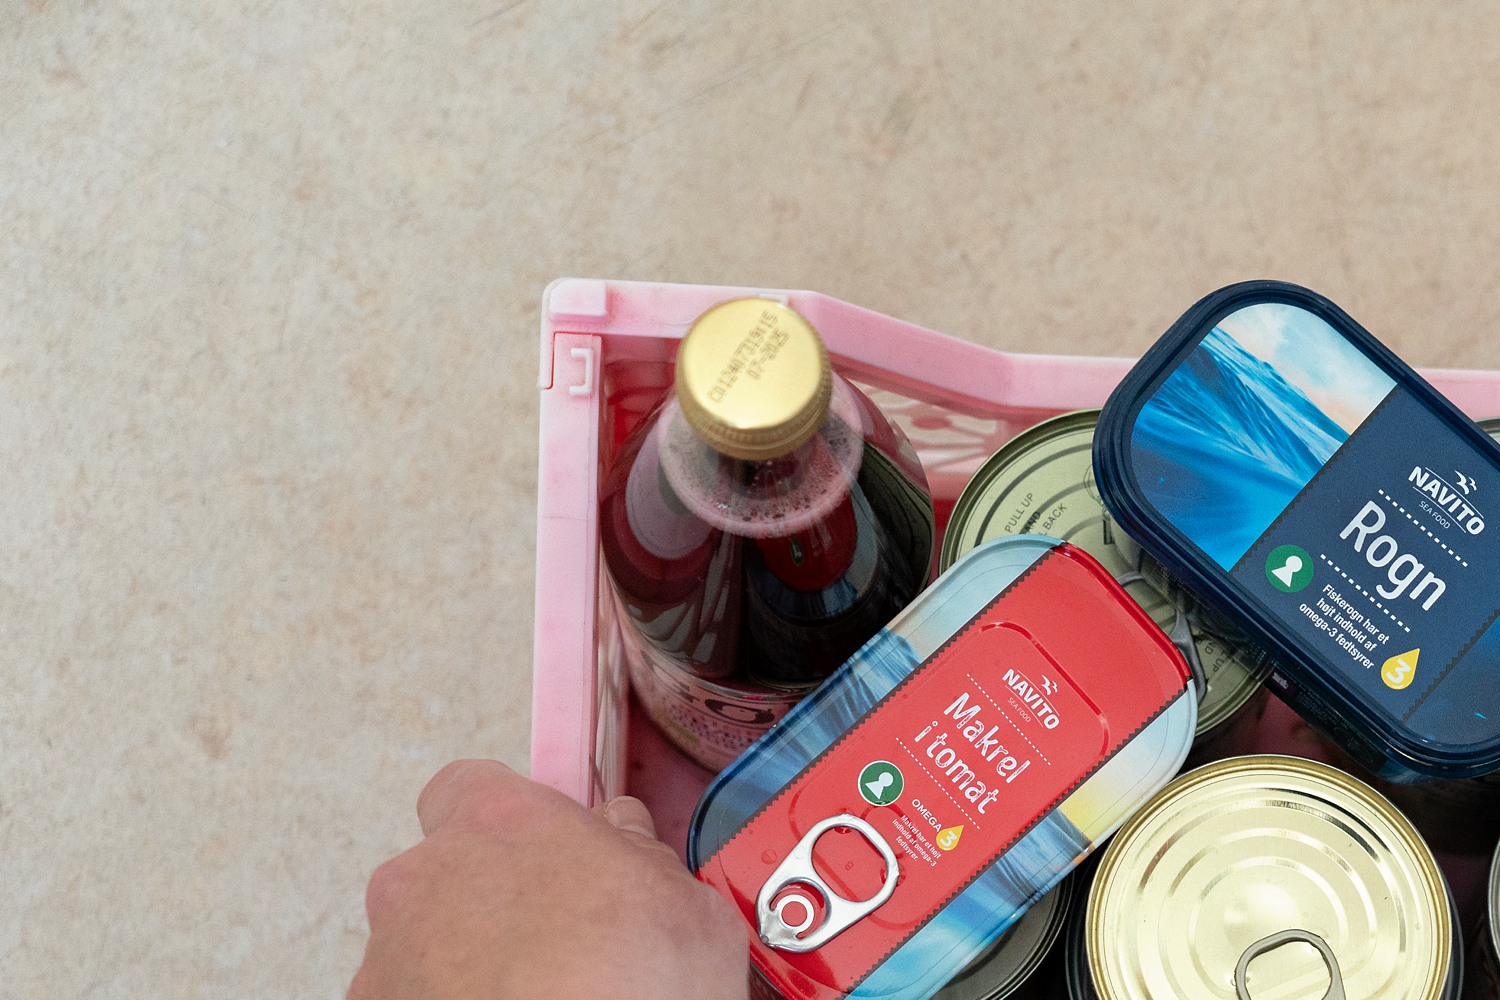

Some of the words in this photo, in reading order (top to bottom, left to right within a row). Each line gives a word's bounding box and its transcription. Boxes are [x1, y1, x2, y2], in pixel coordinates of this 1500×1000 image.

[1004, 508, 1025, 533] PULL
[1024, 492, 1034, 508] UP
[1043, 503, 1068, 530] BACK
[1408, 466, 1485, 535] NAVITO
[1419, 500, 1432, 514] SEA
[1432, 511, 1451, 529] FOOD
[1339, 500, 1446, 611] Rogn
[1299, 603, 1338, 638] omega-3
[1335, 633, 1375, 669] fedtsyrer
[1316, 598, 1336, 617] højt
[1333, 612, 1368, 644] indhold
[1364, 641, 1377, 652] af
[1322, 584, 1364, 623] Fiskerogn
[1362, 619, 1380, 635] har
[1377, 633, 1390, 645] et
[1212, 657, 1224, 673] UP
[1386, 658, 1412, 684] 3
[1002, 668, 1060, 730] NAVITO
[1007, 697, 1018, 709] SEA
[1016, 707, 1032, 723] FOOD
[914, 720, 939, 743] i
[943, 692, 1031, 784] Makrel
[926, 732, 999, 815] tomat
[892, 819, 912, 840] indhold
[909, 837, 917, 846] af
[914, 843, 937, 867] omega-3
[900, 815, 920, 835] Makrel
[916, 830, 927, 843] har
[924, 839, 932, 849] et
[930, 844, 942, 859] højt
[911, 798, 942, 832] OMEGA
[940, 830, 958, 847] 3
